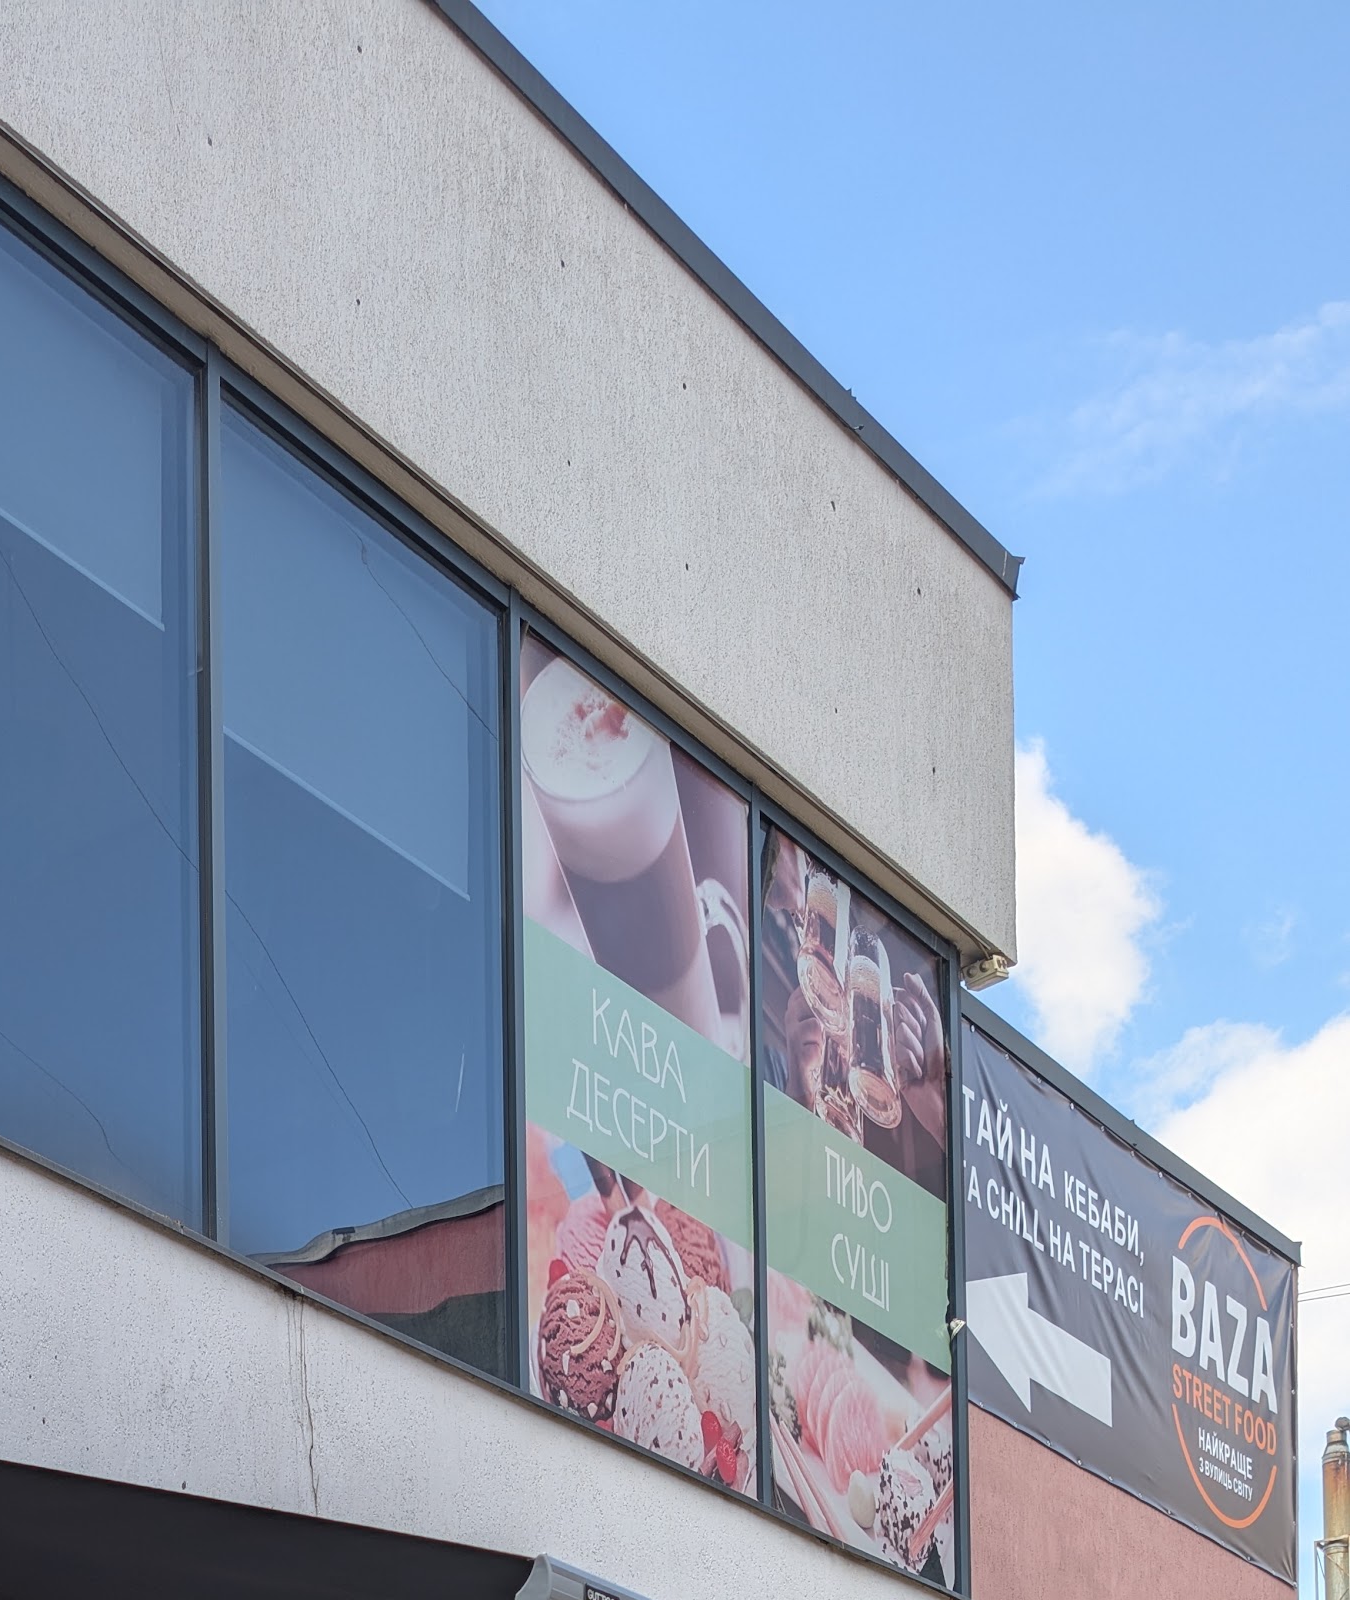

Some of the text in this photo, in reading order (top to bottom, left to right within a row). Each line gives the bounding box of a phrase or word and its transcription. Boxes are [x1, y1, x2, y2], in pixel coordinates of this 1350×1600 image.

[592, 987, 687, 1104] КАВА
[566, 1058, 711, 1197] ДЕСЕРТИ
[824, 1145, 893, 1233] ПИВО
[963, 1159, 1145, 1320] А CHILL НА ТЕРАСІ
[1020, 1126, 1056, 1199] НА
[1064, 1170, 1145, 1267] КЕБАБИ,
[831, 1233, 890, 1312] СУШІ
[1171, 1255, 1279, 1414] BAZA
[1172, 1363, 1277, 1457] STREET FOOD
[1198, 1426, 1253, 1480] НАЙКРАЩЕ
[1204, 1460, 1232, 1490] ВУЛИЦЬ
[1233, 1477, 1253, 1502] СВІТУ
